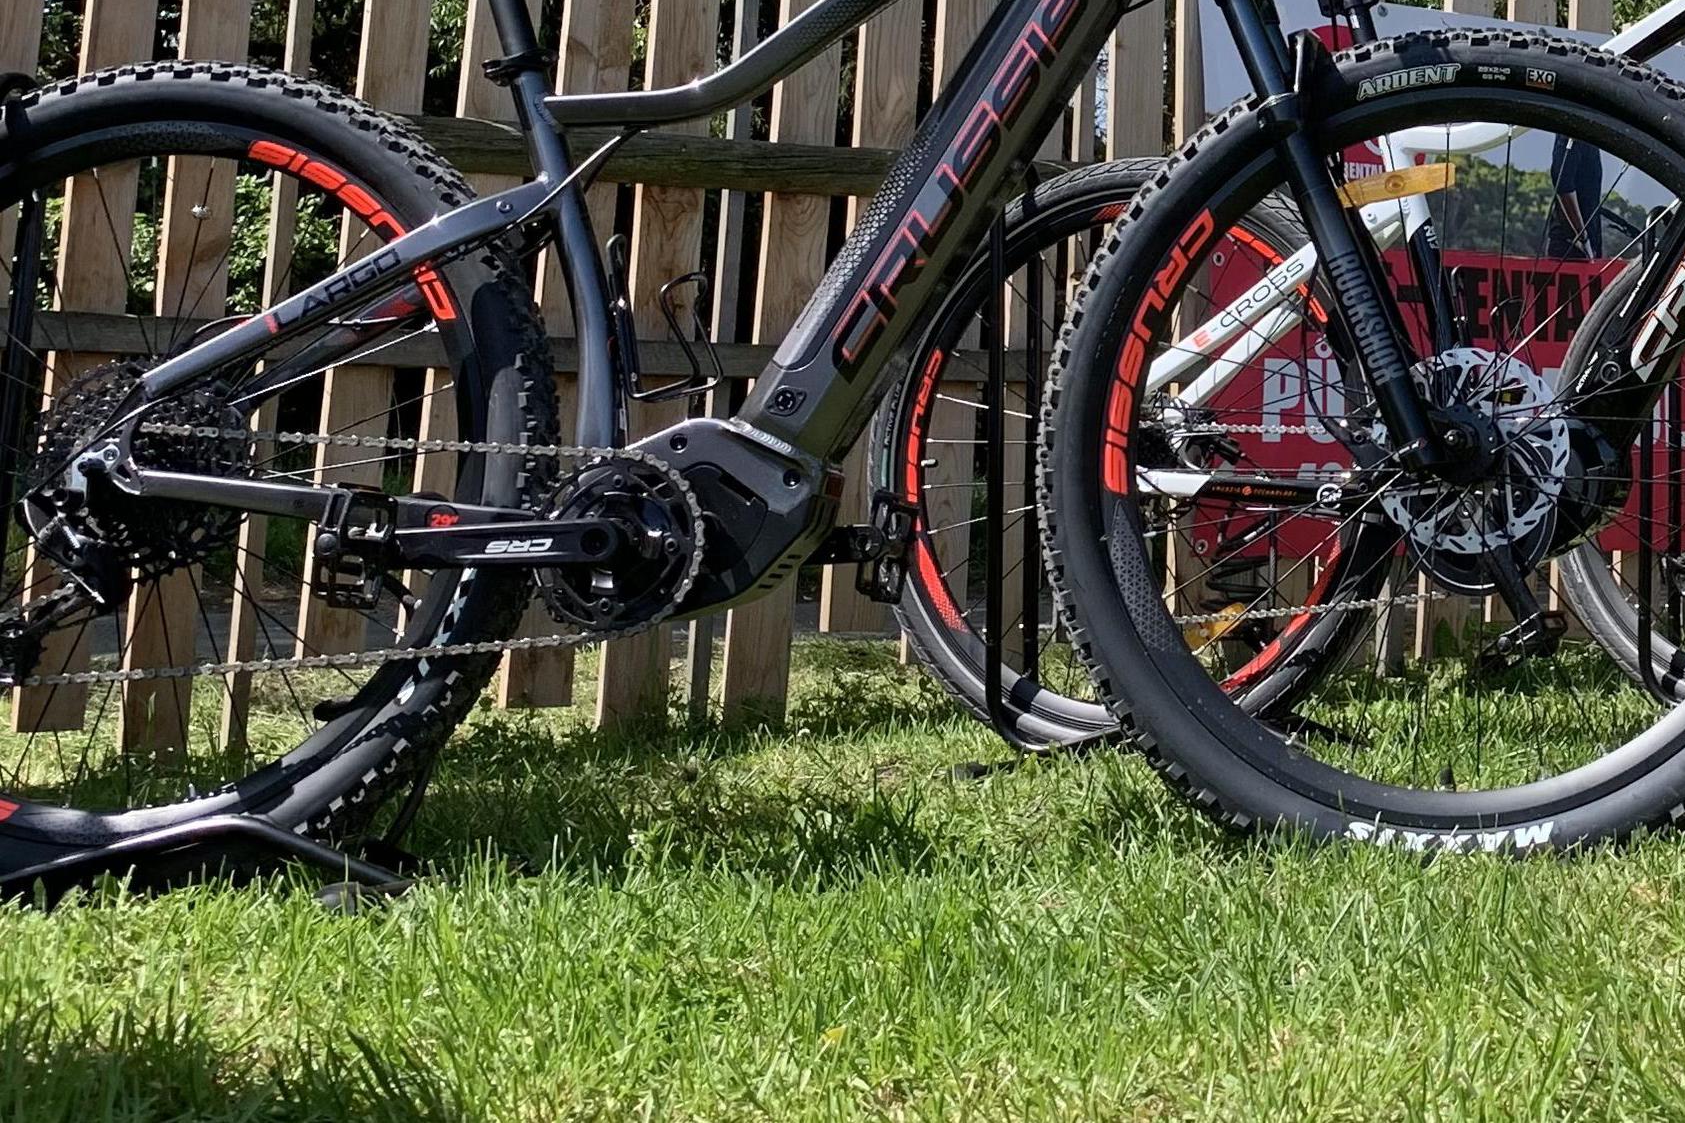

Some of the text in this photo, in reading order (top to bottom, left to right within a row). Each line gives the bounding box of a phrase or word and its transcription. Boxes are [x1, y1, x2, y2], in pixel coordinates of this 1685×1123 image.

[1357, 63, 1461, 101] ARDENT
[1526, 68, 1556, 86] EXO
[1103, 208, 1216, 496] CRUSSIS
[484, 537, 555, 554] CRS
